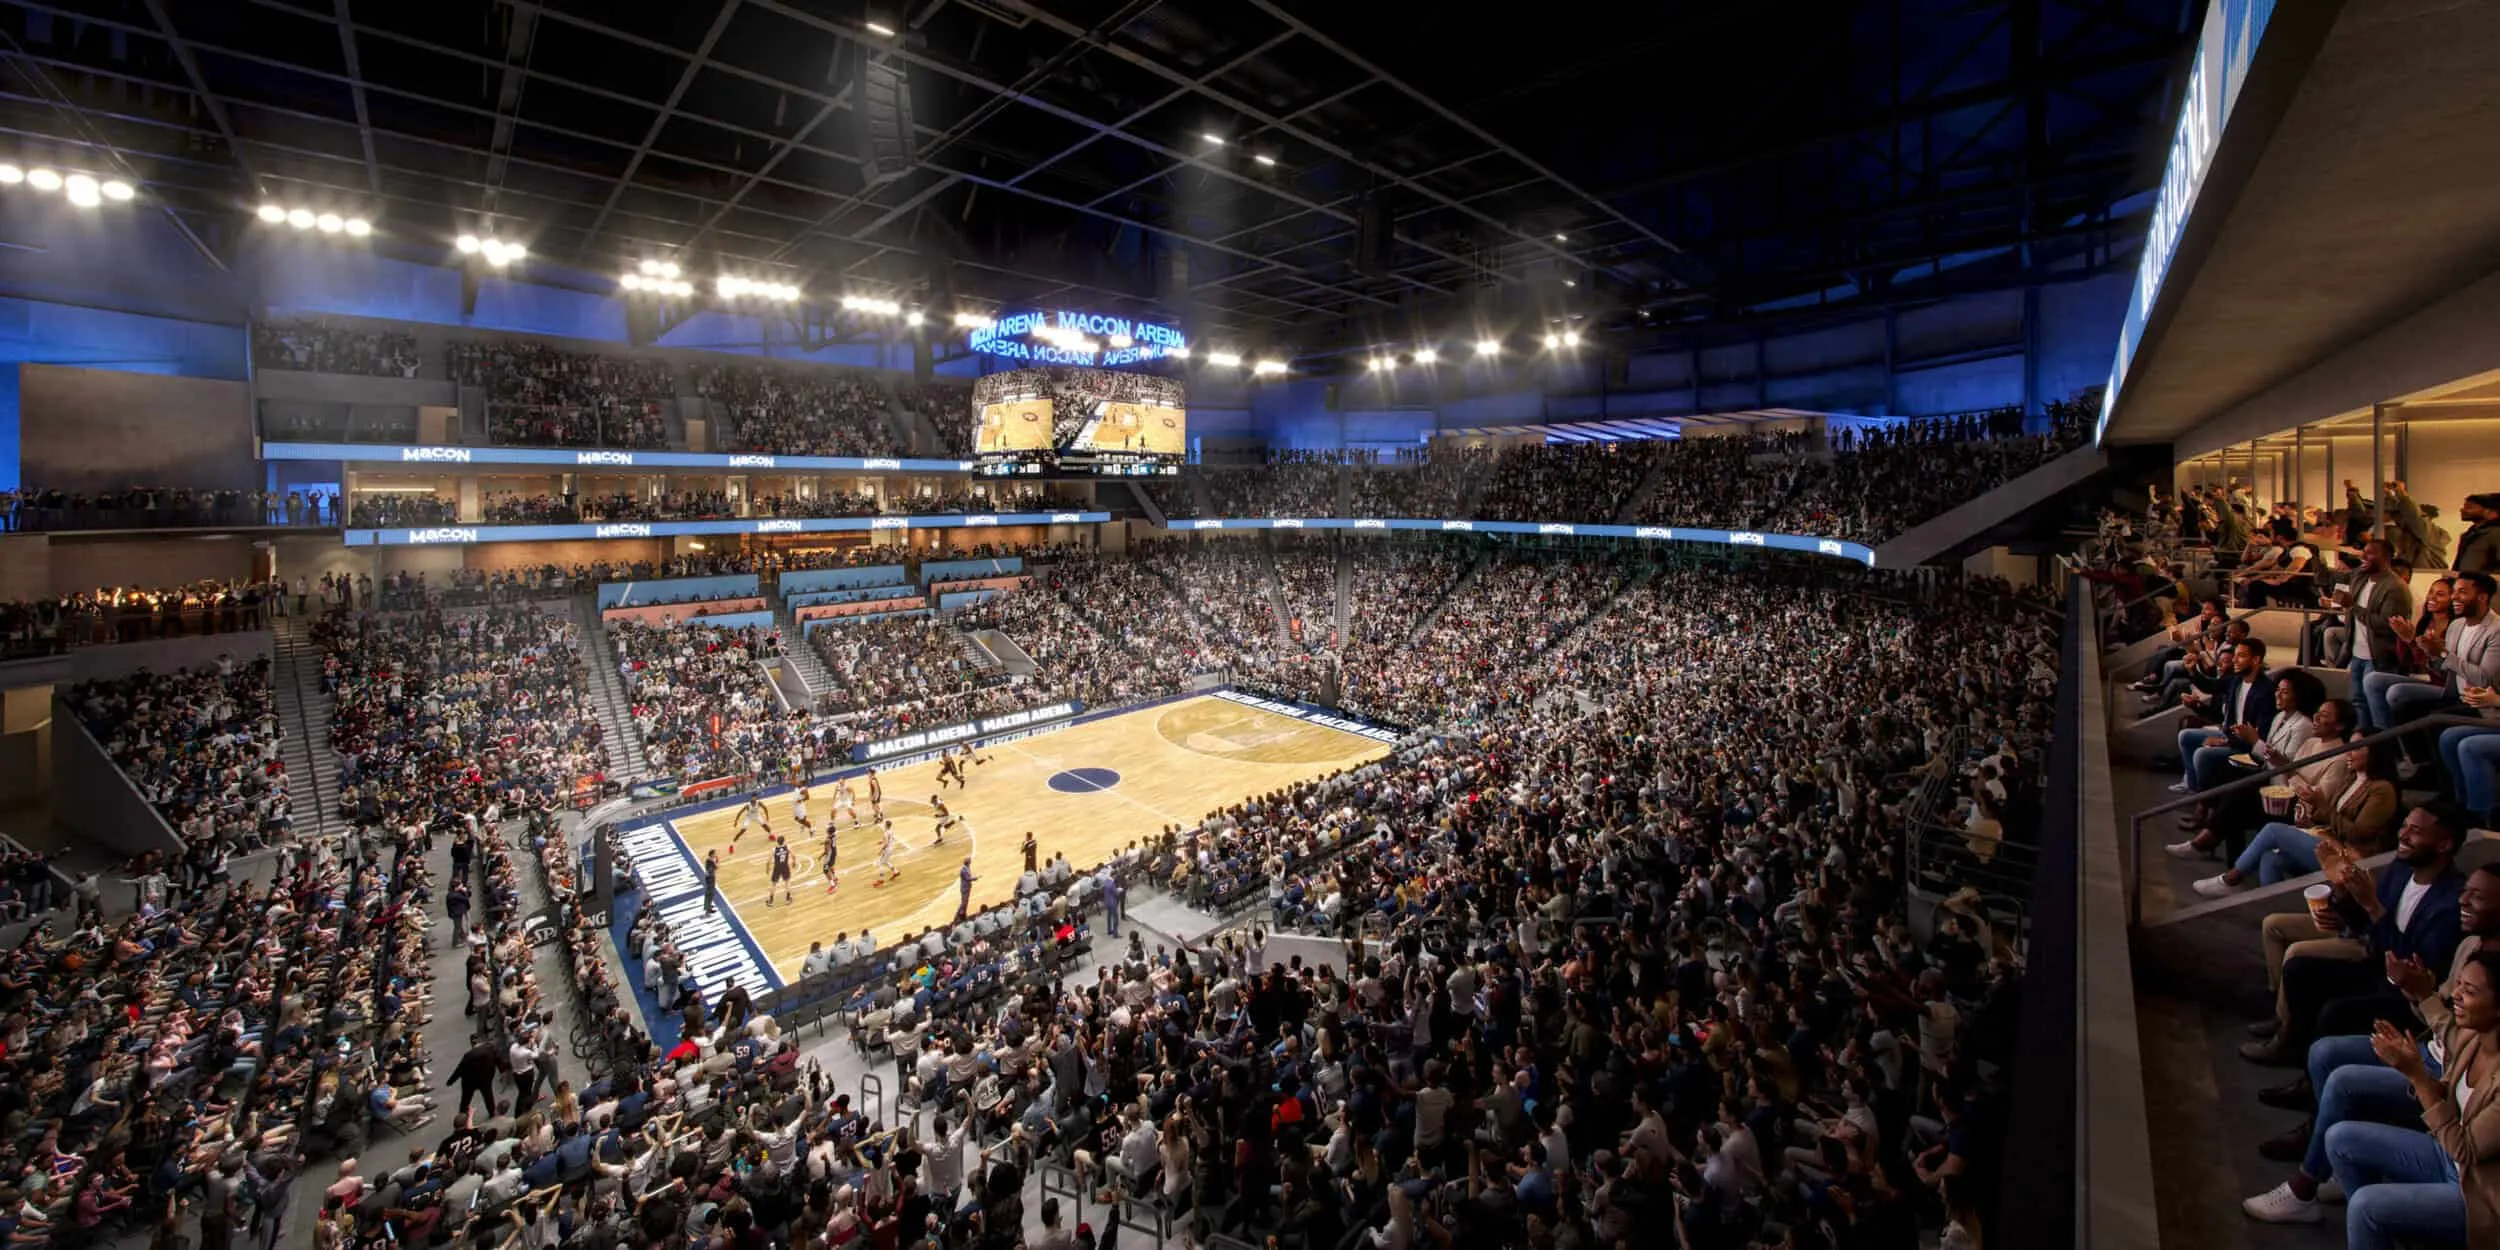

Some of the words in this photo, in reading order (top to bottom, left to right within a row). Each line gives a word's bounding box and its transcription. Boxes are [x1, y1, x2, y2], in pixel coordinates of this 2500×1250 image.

[998, 312, 1047, 338] ARENA
[1058, 311, 1131, 337] MACON
[1135, 322, 1184, 348] ARENA
[869, 733, 926, 758] MACON
[928, 722, 977, 744] ARENA
[983, 709, 1030, 732] MACON
[1031, 703, 1073, 721] ARENA
[736, 1046, 751, 1058] 59
[840, 1120, 857, 1137] 59
[1102, 1125, 1117, 1149] 59
[450, 1135, 473, 1156] 72
